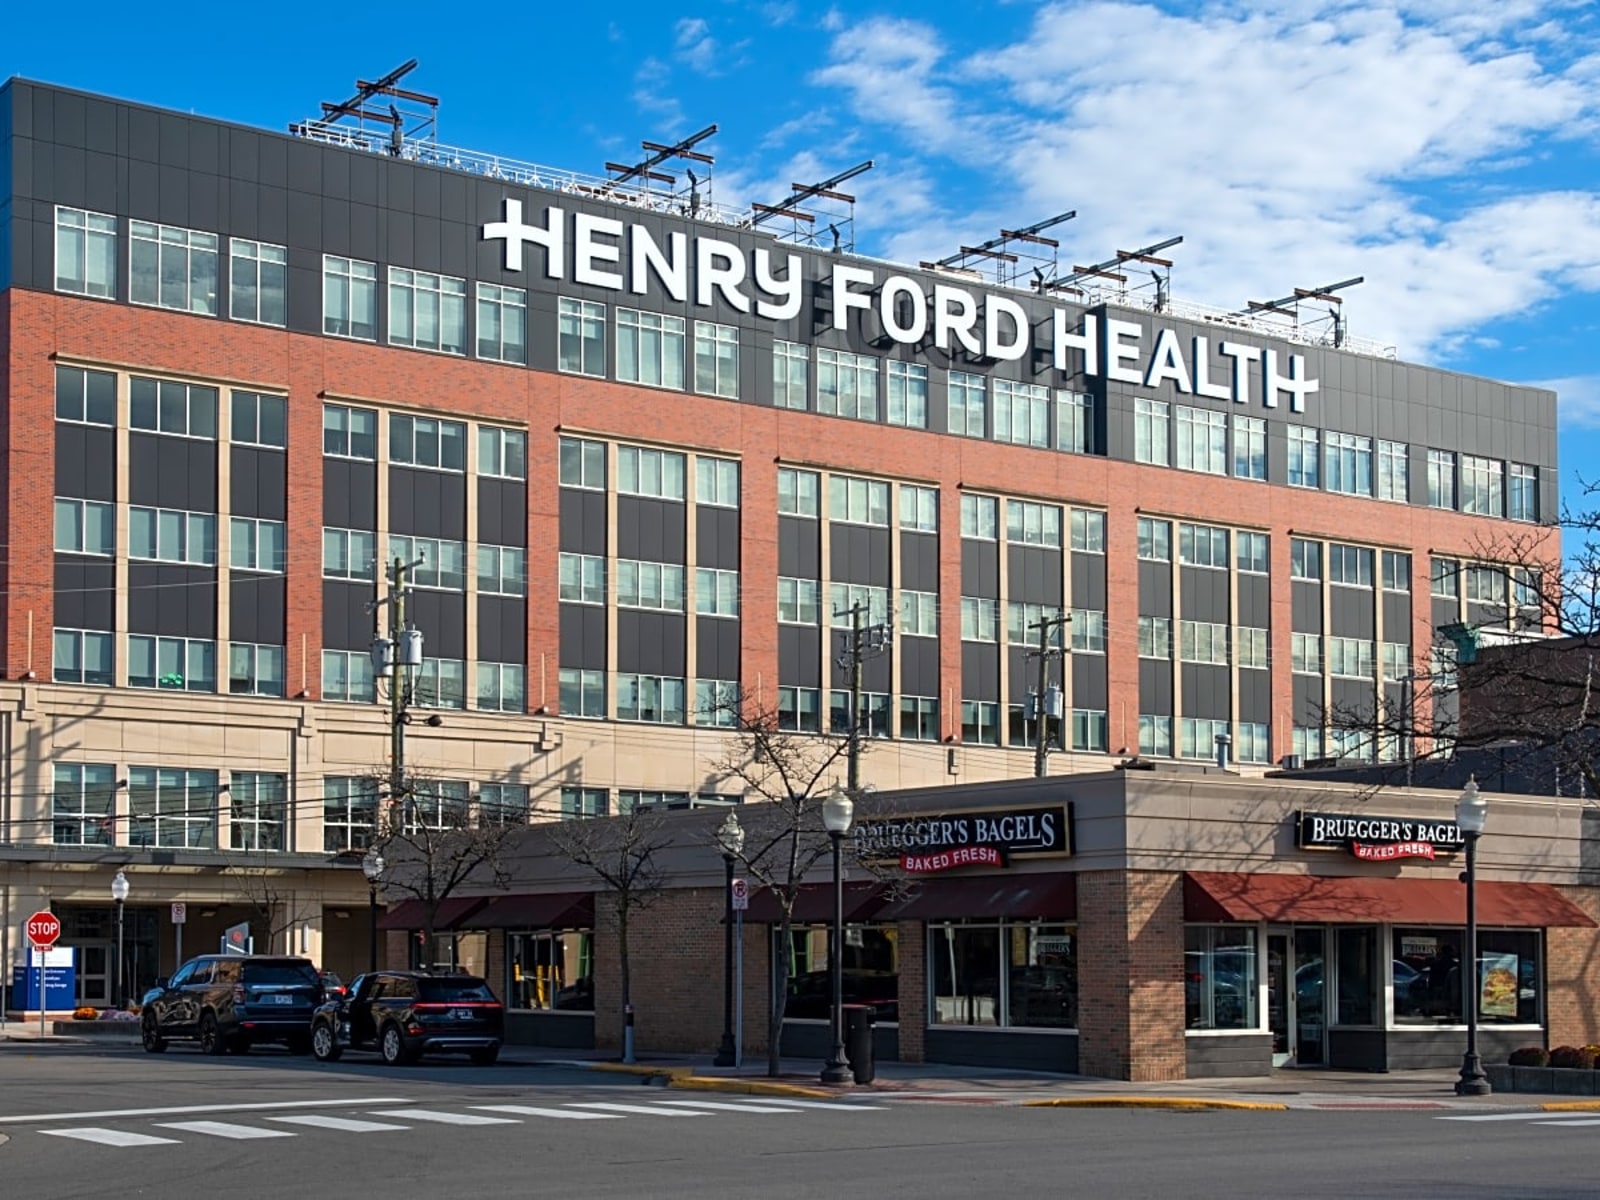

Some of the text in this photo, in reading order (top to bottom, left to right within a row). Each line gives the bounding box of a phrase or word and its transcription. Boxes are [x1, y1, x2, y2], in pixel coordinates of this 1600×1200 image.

[483, 198, 1320, 412] HENRY FORD HEALTH
[976, 813, 1055, 847] BAGELS
[1312, 817, 1465, 843] BRUEGGER'S BAGEL
[906, 847, 997, 871] BAKED FRESH
[1359, 843, 1432, 857] BAKED FRESH
[29, 922, 58, 935] STOP
